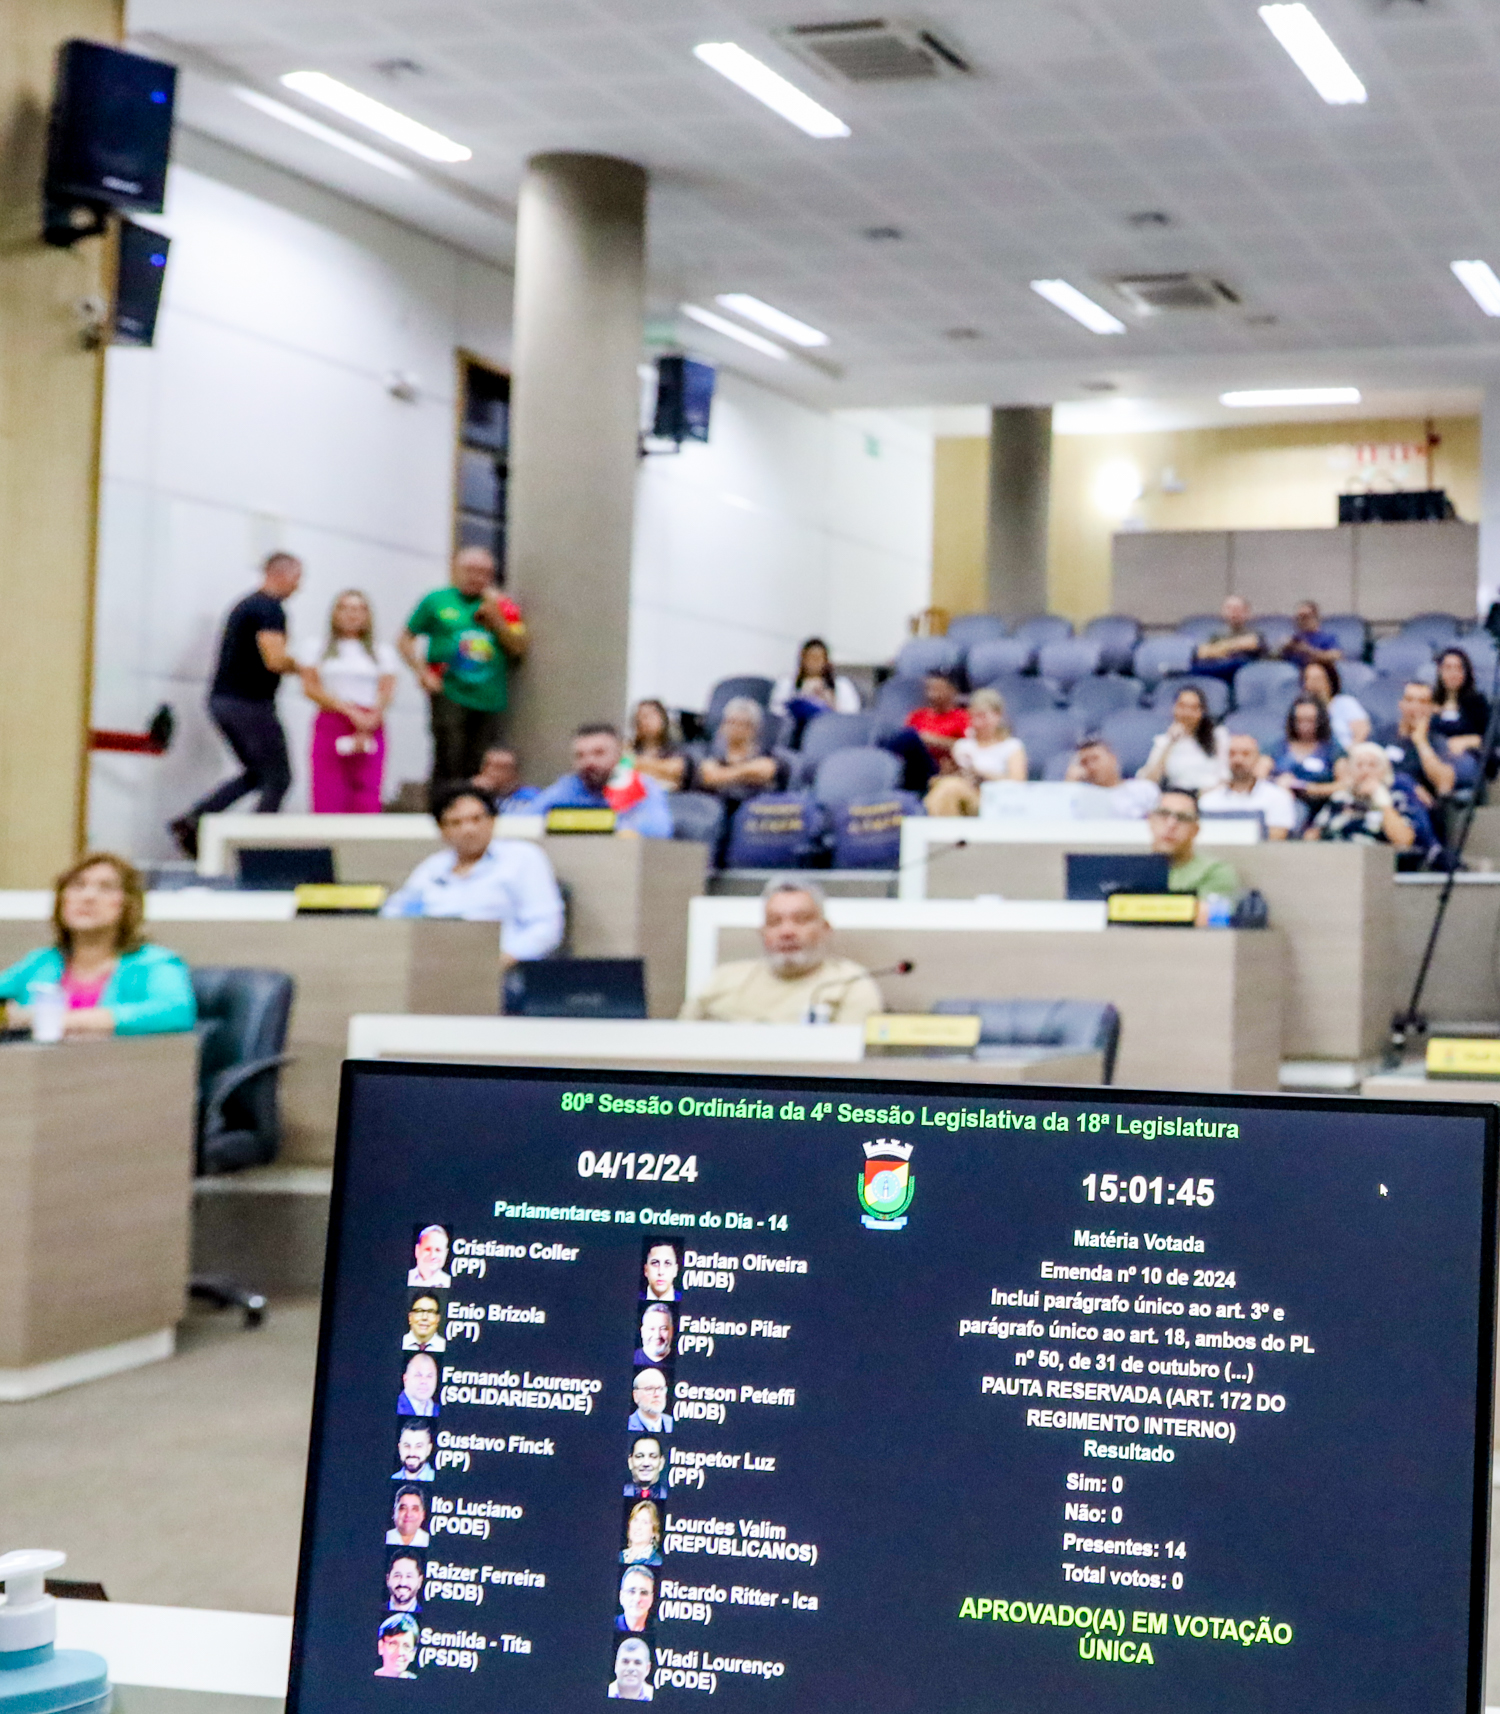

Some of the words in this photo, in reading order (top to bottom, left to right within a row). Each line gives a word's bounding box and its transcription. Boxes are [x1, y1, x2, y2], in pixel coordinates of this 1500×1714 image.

[560, 1091, 595, 1112] 80ª
[597, 1093, 674, 1115] Sessão
[677, 1096, 774, 1120] Ordinária
[779, 1100, 806, 1121] da
[810, 1102, 833, 1122] 4ª
[837, 1103, 916, 1125] Sessão
[921, 1106, 1037, 1132] Legislativa
[1042, 1111, 1069, 1132] da
[1076, 1112, 1110, 1133] 18ª
[1116, 1114, 1239, 1141] Legislatura
[577, 1150, 699, 1183] 04/12/24
[1082, 1172, 1215, 1207] 15:01:45
[493, 1200, 612, 1223] Parlamentares
[614, 1210, 636, 1224] na
[638, 1207, 696, 1227] Ordem
[698, 1210, 722, 1228] do
[724, 1211, 754, 1230] Dia
[767, 1214, 789, 1232] 14
[451, 1240, 527, 1261] Cristiano
[528, 1242, 580, 1262] Coller
[1073, 1229, 1139, 1250] Matéria
[1143, 1232, 1205, 1253] Votada
[450, 1258, 487, 1279] (PP)
[682, 1251, 739, 1273] Darlan
[741, 1253, 808, 1274] Oliveira
[1040, 1260, 1113, 1282] Emenda
[1117, 1265, 1137, 1283] nº
[1140, 1266, 1163, 1285] 10
[1165, 1267, 1190, 1286] de
[1192, 1269, 1237, 1289] 2024
[682, 1270, 735, 1292] (MDB)
[446, 1303, 486, 1324] Enio
[486, 1304, 546, 1324] Brizola
[990, 1288, 1040, 1308] Inclui
[1043, 1291, 1130, 1315] parágrafo
[1133, 1294, 1185, 1316] único
[1188, 1302, 1212, 1318] ao
[1215, 1302, 1246, 1320] art.
[1250, 1301, 1270, 1320] 3º
[1272, 1307, 1285, 1322] e
[444, 1321, 480, 1343] (PT)
[678, 1317, 748, 1337] Fabiano
[750, 1319, 792, 1339] Pilar
[959, 1317, 1045, 1340] parágrafo
[1048, 1320, 1099, 1341] único
[1102, 1327, 1126, 1342] ao
[1129, 1327, 1160, 1345] art.
[1164, 1327, 1191, 1350] 18,
[1194, 1330, 1257, 1351] ambos
[1260, 1333, 1286, 1352] do
[1289, 1334, 1316, 1354] PL
[676, 1335, 715, 1356] (PP)
[1014, 1348, 1035, 1367] nº
[1037, 1349, 1065, 1372] 50,
[1068, 1351, 1092, 1371] de
[1095, 1353, 1116, 1372] 31
[1120, 1354, 1145, 1374] de
[1147, 1358, 1221, 1378] outubro
[1224, 1361, 1254, 1385] (...)
[441, 1368, 521, 1390] Fernando
[522, 1371, 602, 1394] Lourenço
[439, 1387, 593, 1413] (SOLIDARIEDADE)
[673, 1383, 737, 1405] Gerson
[739, 1386, 796, 1406] Peteffi
[981, 1376, 1044, 1397] PAUTA
[1046, 1379, 1163, 1405] RESERVADA
[1165, 1387, 1215, 1409] (ART.
[1220, 1391, 1252, 1411] 172
[1255, 1393, 1286, 1413] DO
[671, 1402, 726, 1424] (MDB)
[1026, 1409, 1140, 1434] REGIMENTO
[1143, 1416, 1236, 1444] INTERNO)
[435, 1432, 506, 1454] Gustavo
[507, 1435, 555, 1456] Finck
[1083, 1439, 1175, 1463] Resultado
[434, 1451, 471, 1472] (PP)
[668, 1449, 742, 1471] Inspetor
[743, 1452, 776, 1472] Luz
[667, 1467, 705, 1488] (PP)
[1065, 1472, 1107, 1493] Sim:
[1111, 1475, 1124, 1494] 0
[430, 1496, 454, 1515] Ito
[455, 1498, 523, 1520] Luciano
[1064, 1501, 1107, 1523] Não:
[1111, 1505, 1123, 1525] 0
[428, 1516, 491, 1539] (PODE)
[664, 1515, 736, 1537] Lourdes
[738, 1519, 787, 1541] Valim
[662, 1534, 818, 1564] (REPUBLICANOS)
[1061, 1532, 1160, 1558] Presentes:
[1164, 1540, 1187, 1560] 14
[425, 1562, 480, 1584] Raizer
[479, 1566, 546, 1589] Ferreira
[1061, 1563, 1106, 1585] Total
[1109, 1569, 1167, 1590] votos:
[1171, 1571, 1184, 1591] 0
[423, 1581, 484, 1605] (PSDB)
[658, 1581, 728, 1603] Ricardo
[728, 1586, 780, 1608] Ritter
[791, 1591, 819, 1611] Ica
[657, 1601, 712, 1624] (MDB)
[958, 1596, 1126, 1636] APROVADO(A)
[1131, 1610, 1168, 1635] EM
[1173, 1613, 1293, 1645] VOTAÇÃO
[418, 1629, 487, 1651] Semilda
[499, 1634, 532, 1655] Tita
[1078, 1633, 1155, 1665] ÚNICA
[417, 1648, 479, 1672] (PSDB)
[654, 1649, 699, 1673] Vladi
[700, 1653, 785, 1678] Lourenço
[652, 1669, 717, 1694] (PODE)
